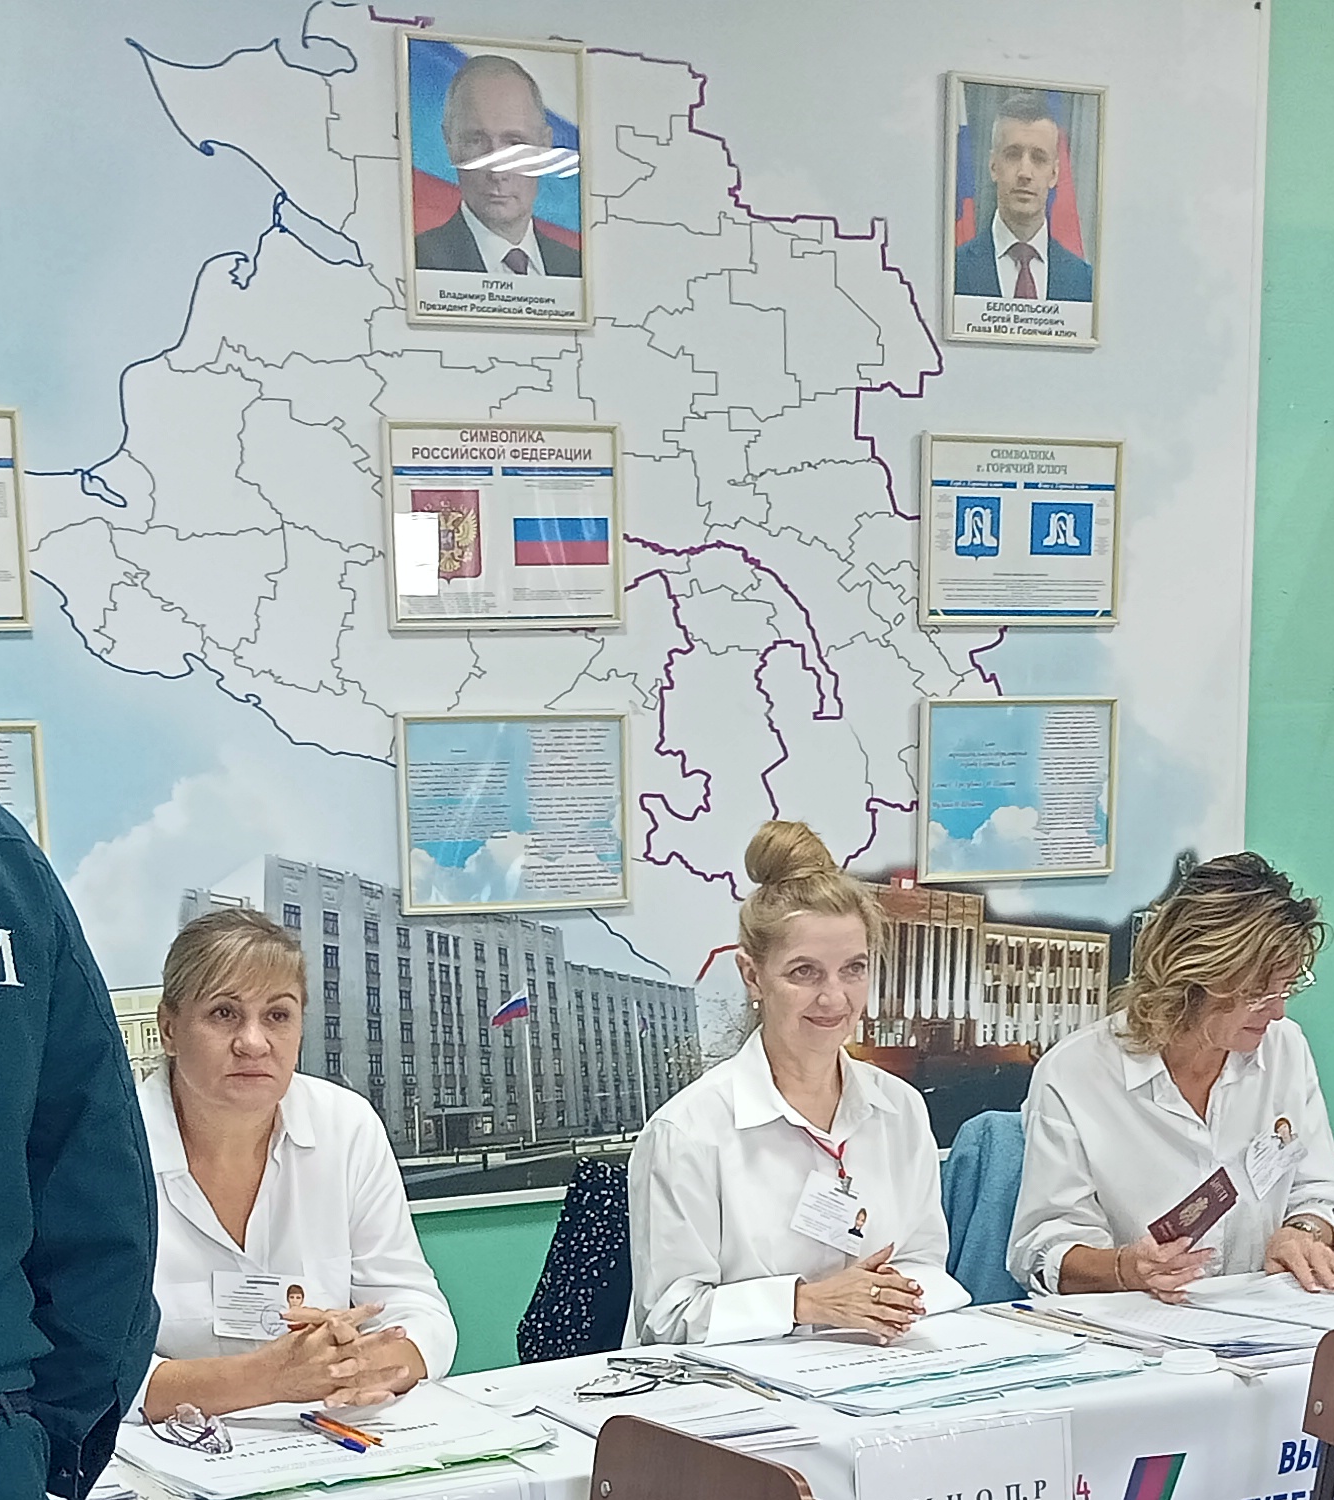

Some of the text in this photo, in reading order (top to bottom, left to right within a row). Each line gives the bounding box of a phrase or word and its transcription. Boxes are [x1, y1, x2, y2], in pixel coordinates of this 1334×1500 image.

[482, 280, 514, 290] ПУТИН
[439, 290, 556, 305] Владимир Владимирович
[419, 301, 576, 318] Президент Российской Федерации
[986, 301, 1060, 314] БЕЛОПОЛЬСКИЙ
[981, 313, 1065, 327] Сергей Викторович
[967, 323, 992, 333] Глава
[994, 325, 1008, 335] МО
[459, 430, 545, 443] СИМВОЛИКА
[411, 445, 593, 462] РОССИЙСКОЙ ФЕДЕРАЦИИ
[990, 449, 1056, 461] СИМВОЛИКА
[986, 462, 1035, 474] ГОРЯЧИЙ
[1036, 464, 1068, 475] КЛЮЧ
[1034, 1479, 1047, 1500] Р
